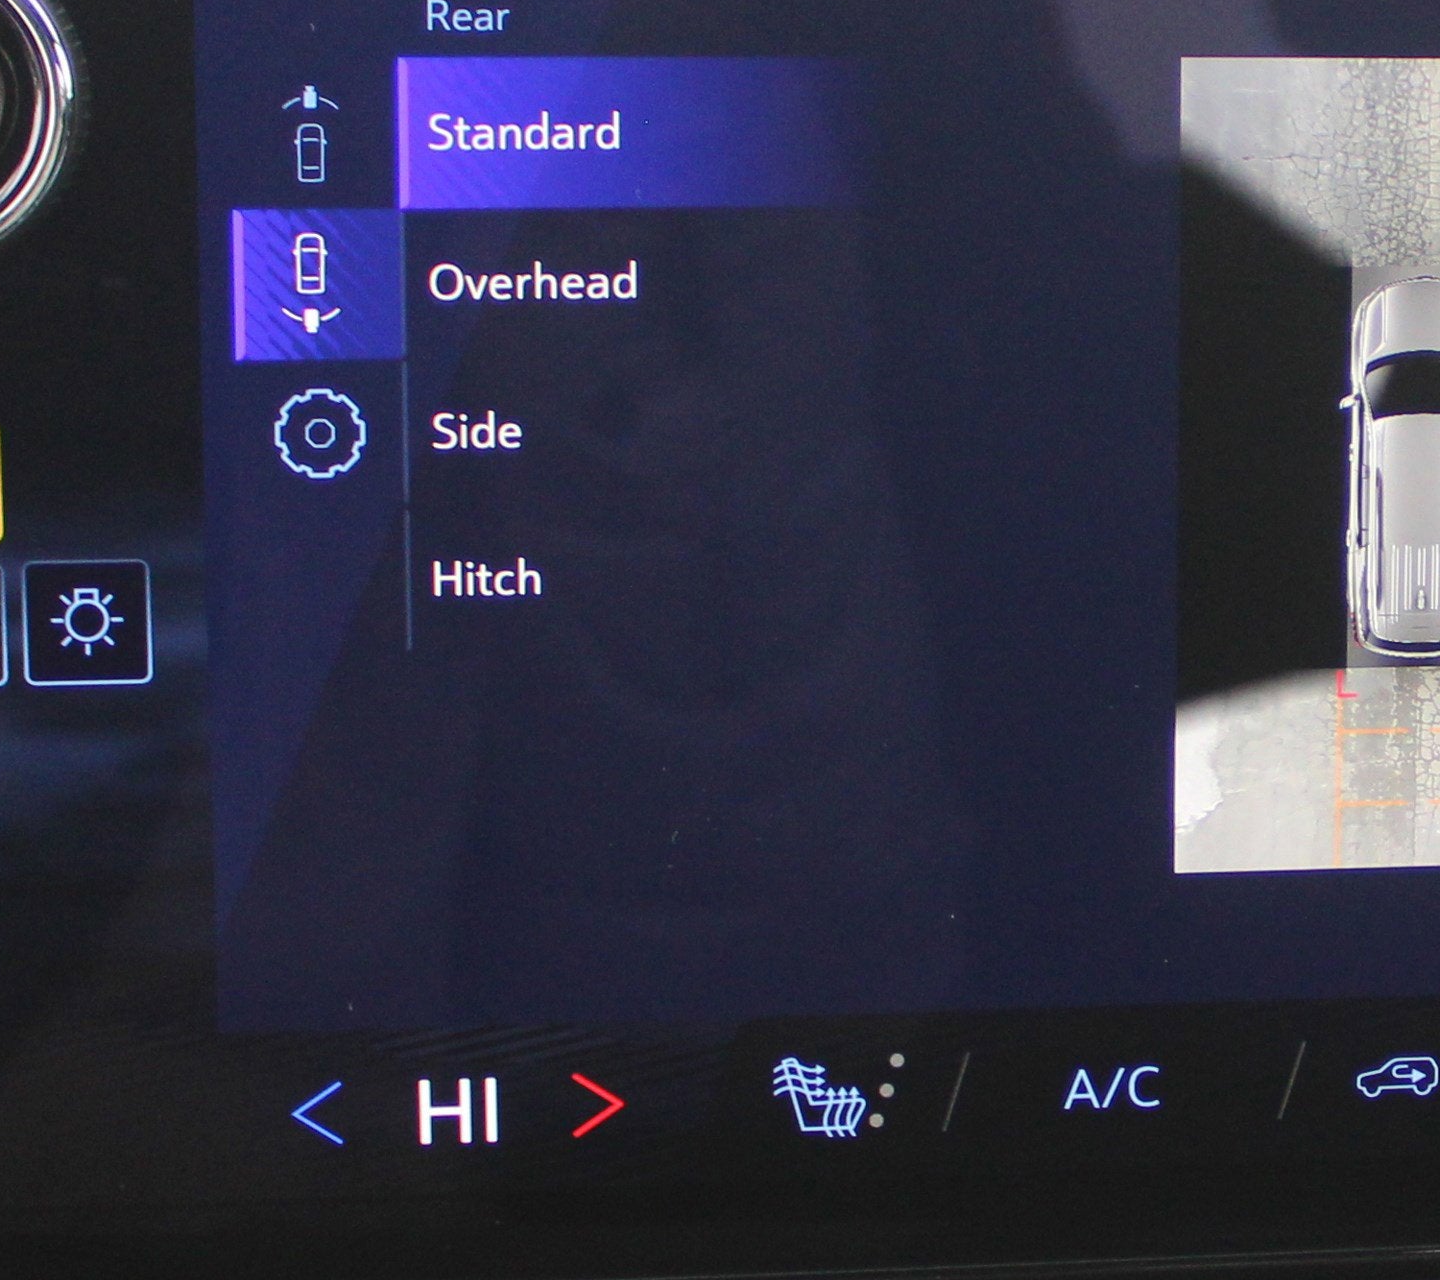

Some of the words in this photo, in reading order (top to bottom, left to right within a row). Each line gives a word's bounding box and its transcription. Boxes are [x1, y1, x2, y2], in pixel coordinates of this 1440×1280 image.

[427, 110, 622, 151] Standard
[427, 260, 639, 301] Overhead
[431, 412, 523, 450] Side
[432, 557, 543, 597] Hitch
[1063, 1063, 1162, 1112] A/C
[416, 1074, 500, 1146] HI
